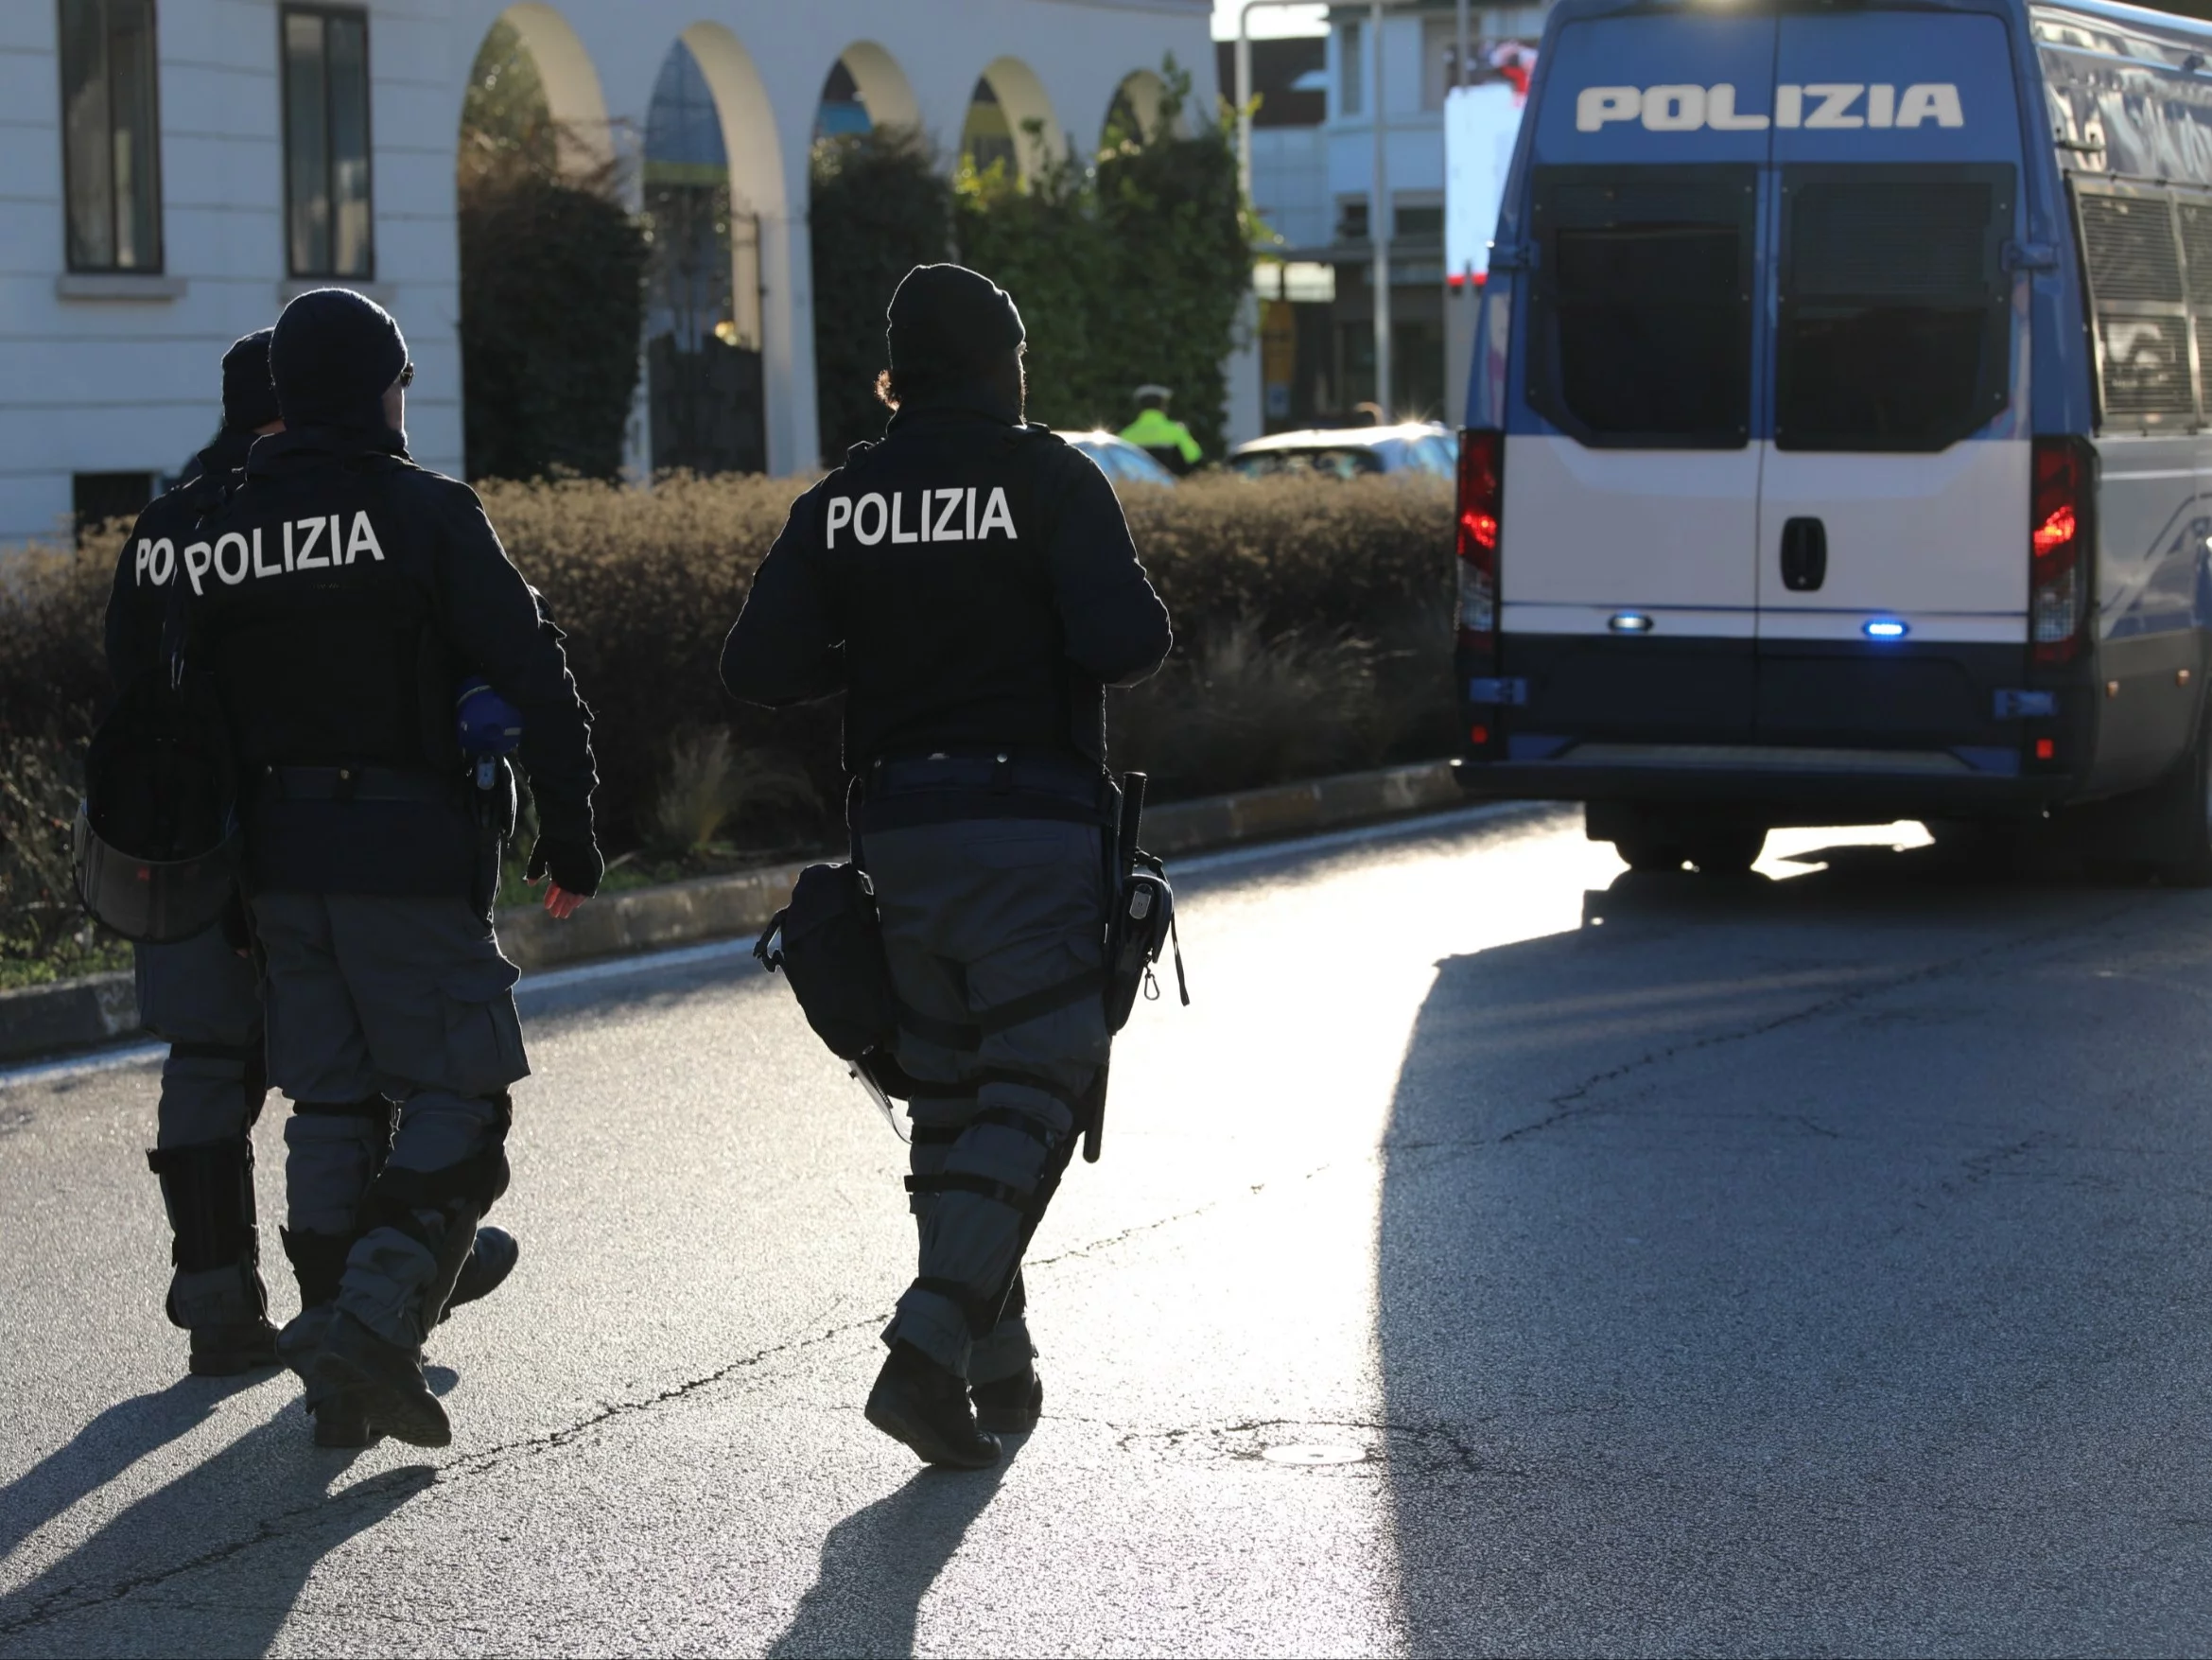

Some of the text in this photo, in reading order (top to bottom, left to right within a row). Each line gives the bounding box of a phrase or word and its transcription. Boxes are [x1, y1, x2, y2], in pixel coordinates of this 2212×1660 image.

[1576, 83, 1964, 131] POLIZIA
[827, 486, 1019, 550] POLIZIA
[183, 510, 385, 596] POLIZIA
